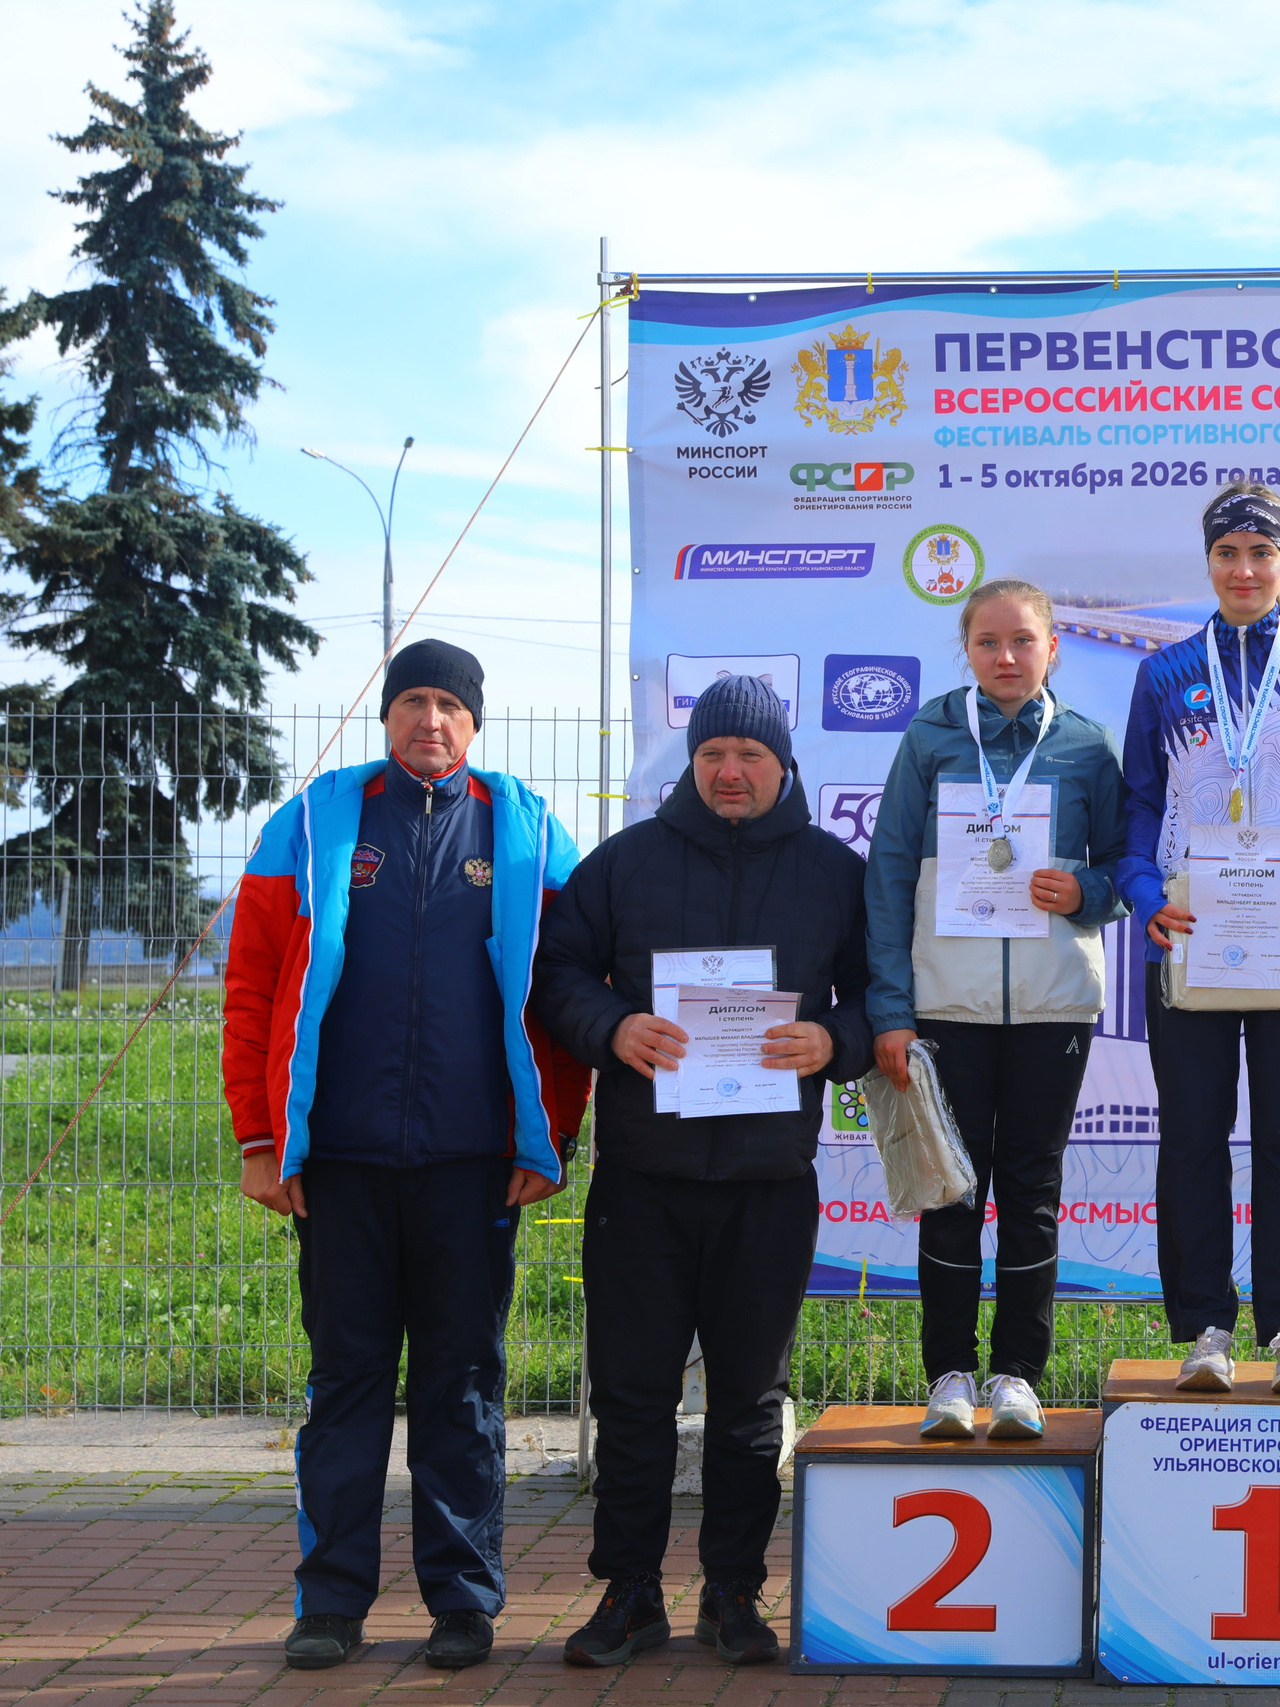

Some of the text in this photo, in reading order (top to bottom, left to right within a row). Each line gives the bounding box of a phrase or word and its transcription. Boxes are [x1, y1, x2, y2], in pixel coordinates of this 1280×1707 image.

[934, 379, 1243, 414] ВСЕРОССИЙСКИЕ
[933, 425, 1091, 448] ФЕСТИВАЛЬ
[676, 446, 768, 459] МИНСПОРТ
[688, 466, 757, 479] РОССИИ
[938, 464, 952, 488] 1
[980, 463, 998, 488] 5
[1005, 462, 1123, 494] октября
[1131, 461, 1208, 487] 2026
[701, 549, 866, 565] МИНСПОРТ
[832, 666, 912, 705] РУССКОЕ ГЕОГРАФИЧЕСКОЕ ОБЩЕСТВО
[840, 707, 874, 720] ОСНОВАНО
[881, 709, 896, 719] 1845
[966, 824, 1021, 834] ДИПОМ
[1219, 868, 1275, 878] ДИПЛОМ
[708, 1006, 765, 1014] ДИПЛОМ
[1140, 1417, 1251, 1434] ФЕДЕРАЦИЯ
[887, 1488, 997, 1632] 2
